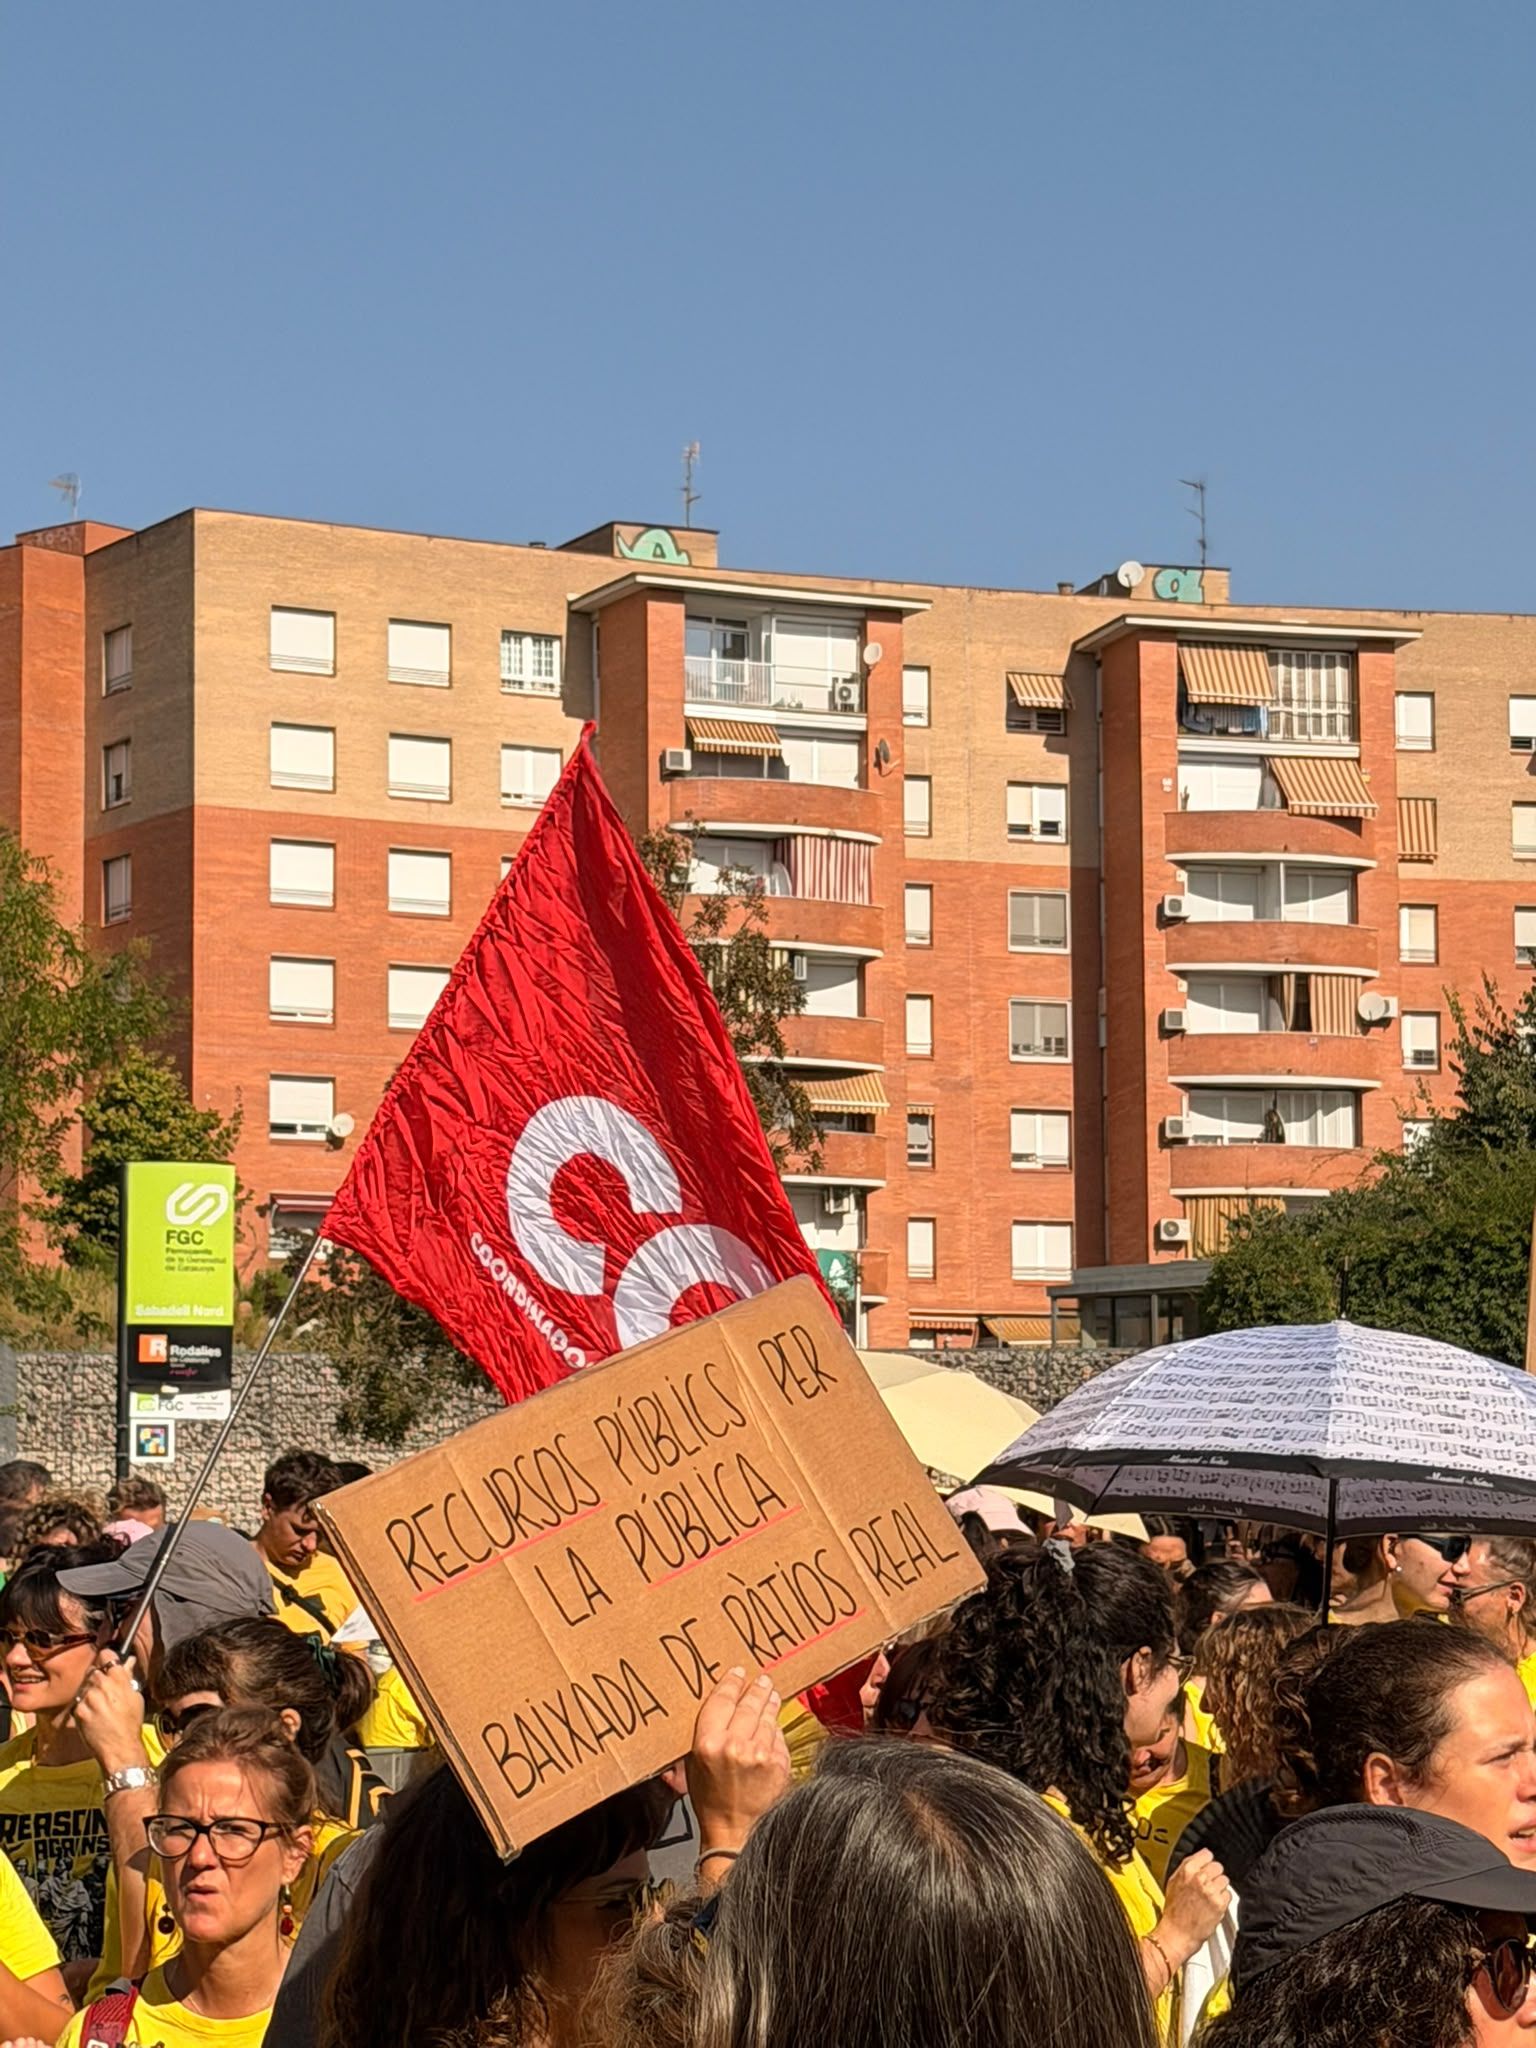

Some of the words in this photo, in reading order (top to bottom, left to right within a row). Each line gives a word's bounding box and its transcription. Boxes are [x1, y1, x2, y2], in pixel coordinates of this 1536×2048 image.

[165, 1229, 204, 1245] FGC
[135, 1304, 190, 1318] Sabadell
[192, 1304, 225, 1318] Nord
[470, 1232, 596, 1370] COORDINADO
[149, 1339, 167, 1357] R
[169, 1344, 222, 1358] Rodalies
[158, 1400, 184, 1411] FGC
[385, 1433, 602, 1591] RECURSOS
[757, 1324, 839, 1405] PER
[534, 1546, 614, 1627] LA
[481, 1657, 669, 1800] BAIXADA
[659, 1617, 721, 1700] DE
[848, 1501, 960, 1597] REAL
[34, 1835, 112, 1860] AGAINS
